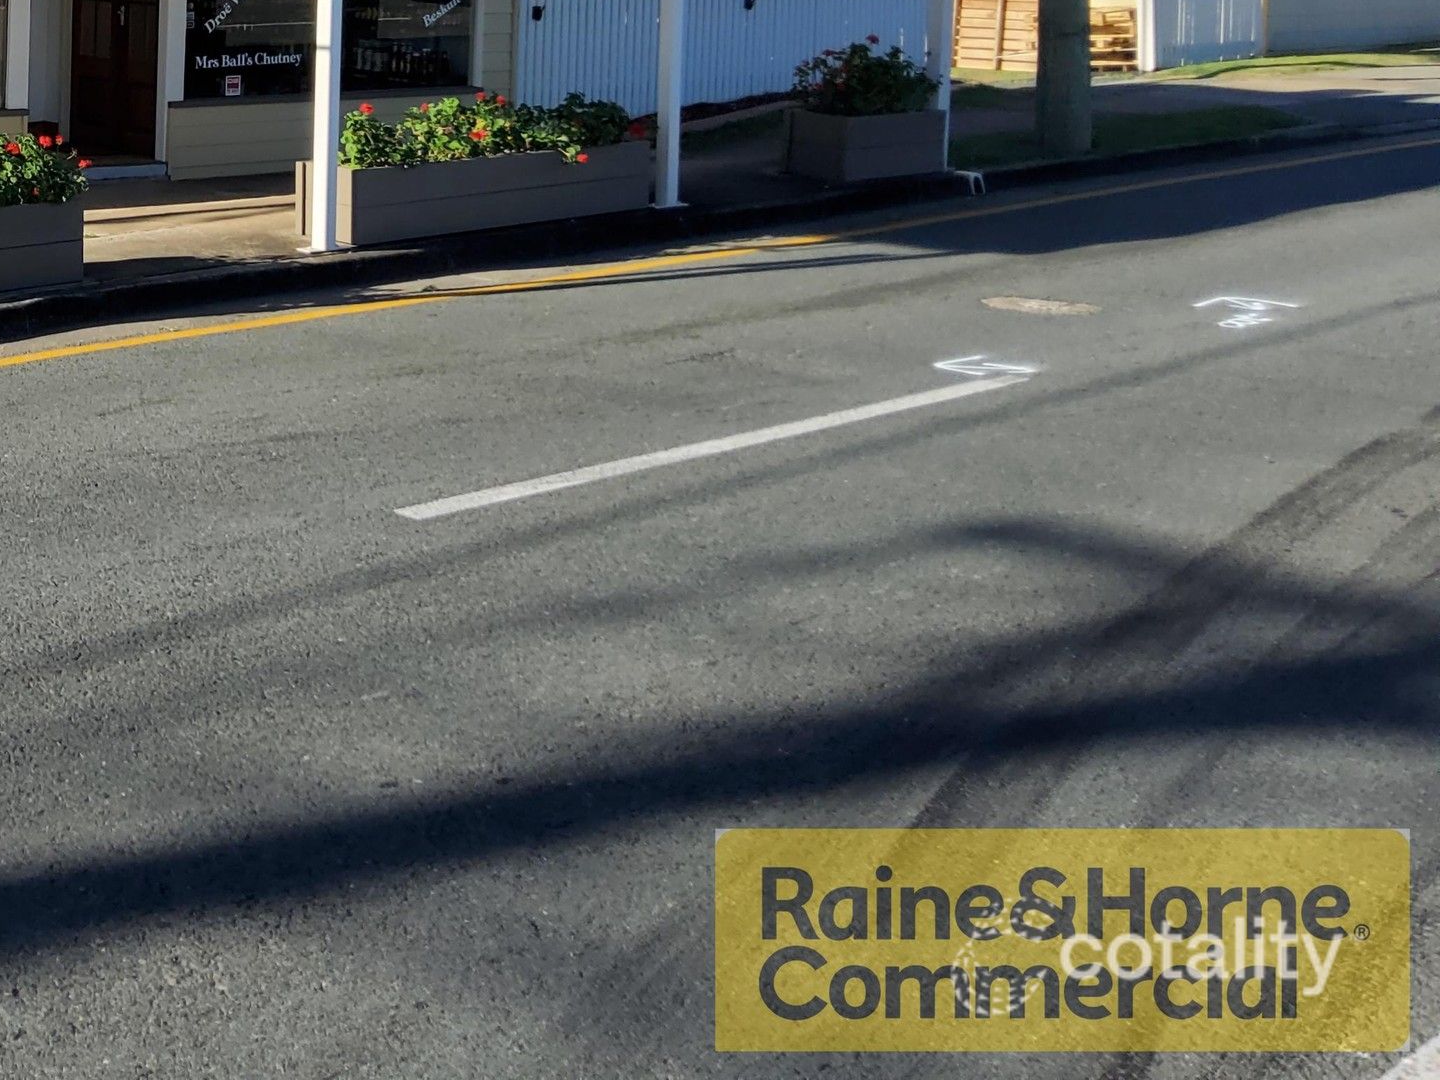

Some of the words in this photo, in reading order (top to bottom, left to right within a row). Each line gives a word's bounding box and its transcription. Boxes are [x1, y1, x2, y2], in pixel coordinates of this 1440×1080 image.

[203, 2, 232, 34] Droë
[195, 55, 220, 69] Mrs
[221, 52, 253, 68] Ball's
[254, 52, 303, 67] Chutney
